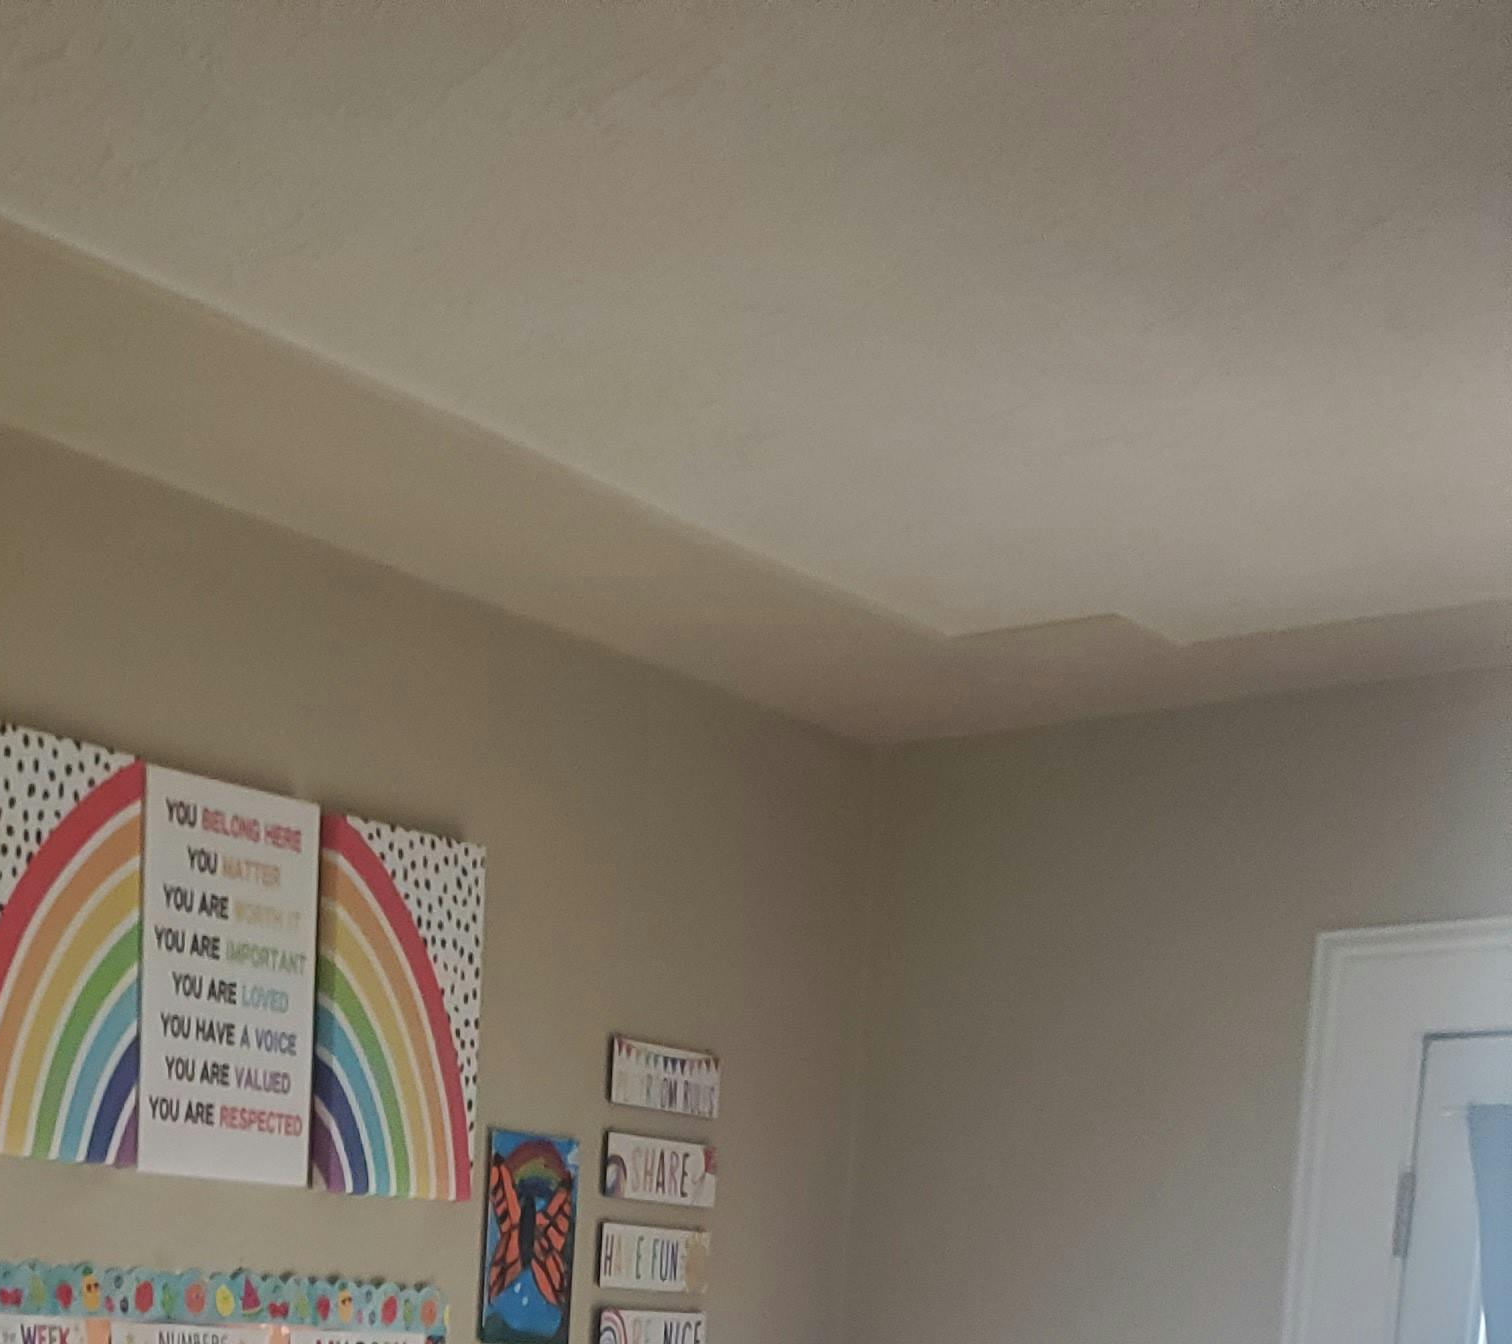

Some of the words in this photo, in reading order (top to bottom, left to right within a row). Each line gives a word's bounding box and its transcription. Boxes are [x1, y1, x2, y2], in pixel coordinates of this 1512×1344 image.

[166, 796, 198, 828] YOU
[202, 807, 260, 842] BELONG
[264, 824, 302, 853] HERE
[187, 844, 218, 875] YOU
[222, 854, 281, 888] MATTER
[163, 883, 194, 913] YOU
[199, 892, 229, 919] ARE
[154, 924, 185, 954] YOU
[190, 933, 220, 960] ARE
[225, 941, 307, 975] IMPORTANT
[172, 971, 203, 999] YOU
[207, 978, 237, 1005] ARE
[242, 985, 289, 1013] LOVED
[160, 1011, 191, 1039] YOU
[196, 1018, 236, 1046] HAVE
[240, 1025, 250, 1049] A
[255, 1028, 297, 1056] VOICE
[165, 1055, 195, 1082] YOU
[200, 1060, 230, 1086] ARE
[234, 1065, 291, 1095] VALUED
[149, 1095, 180, 1122] YOU
[184, 1101, 215, 1126] ARE
[220, 1104, 303, 1137] RESPECTED
[631, 1148, 690, 1198] SHARE
[652, 1238, 678, 1282] FUN
